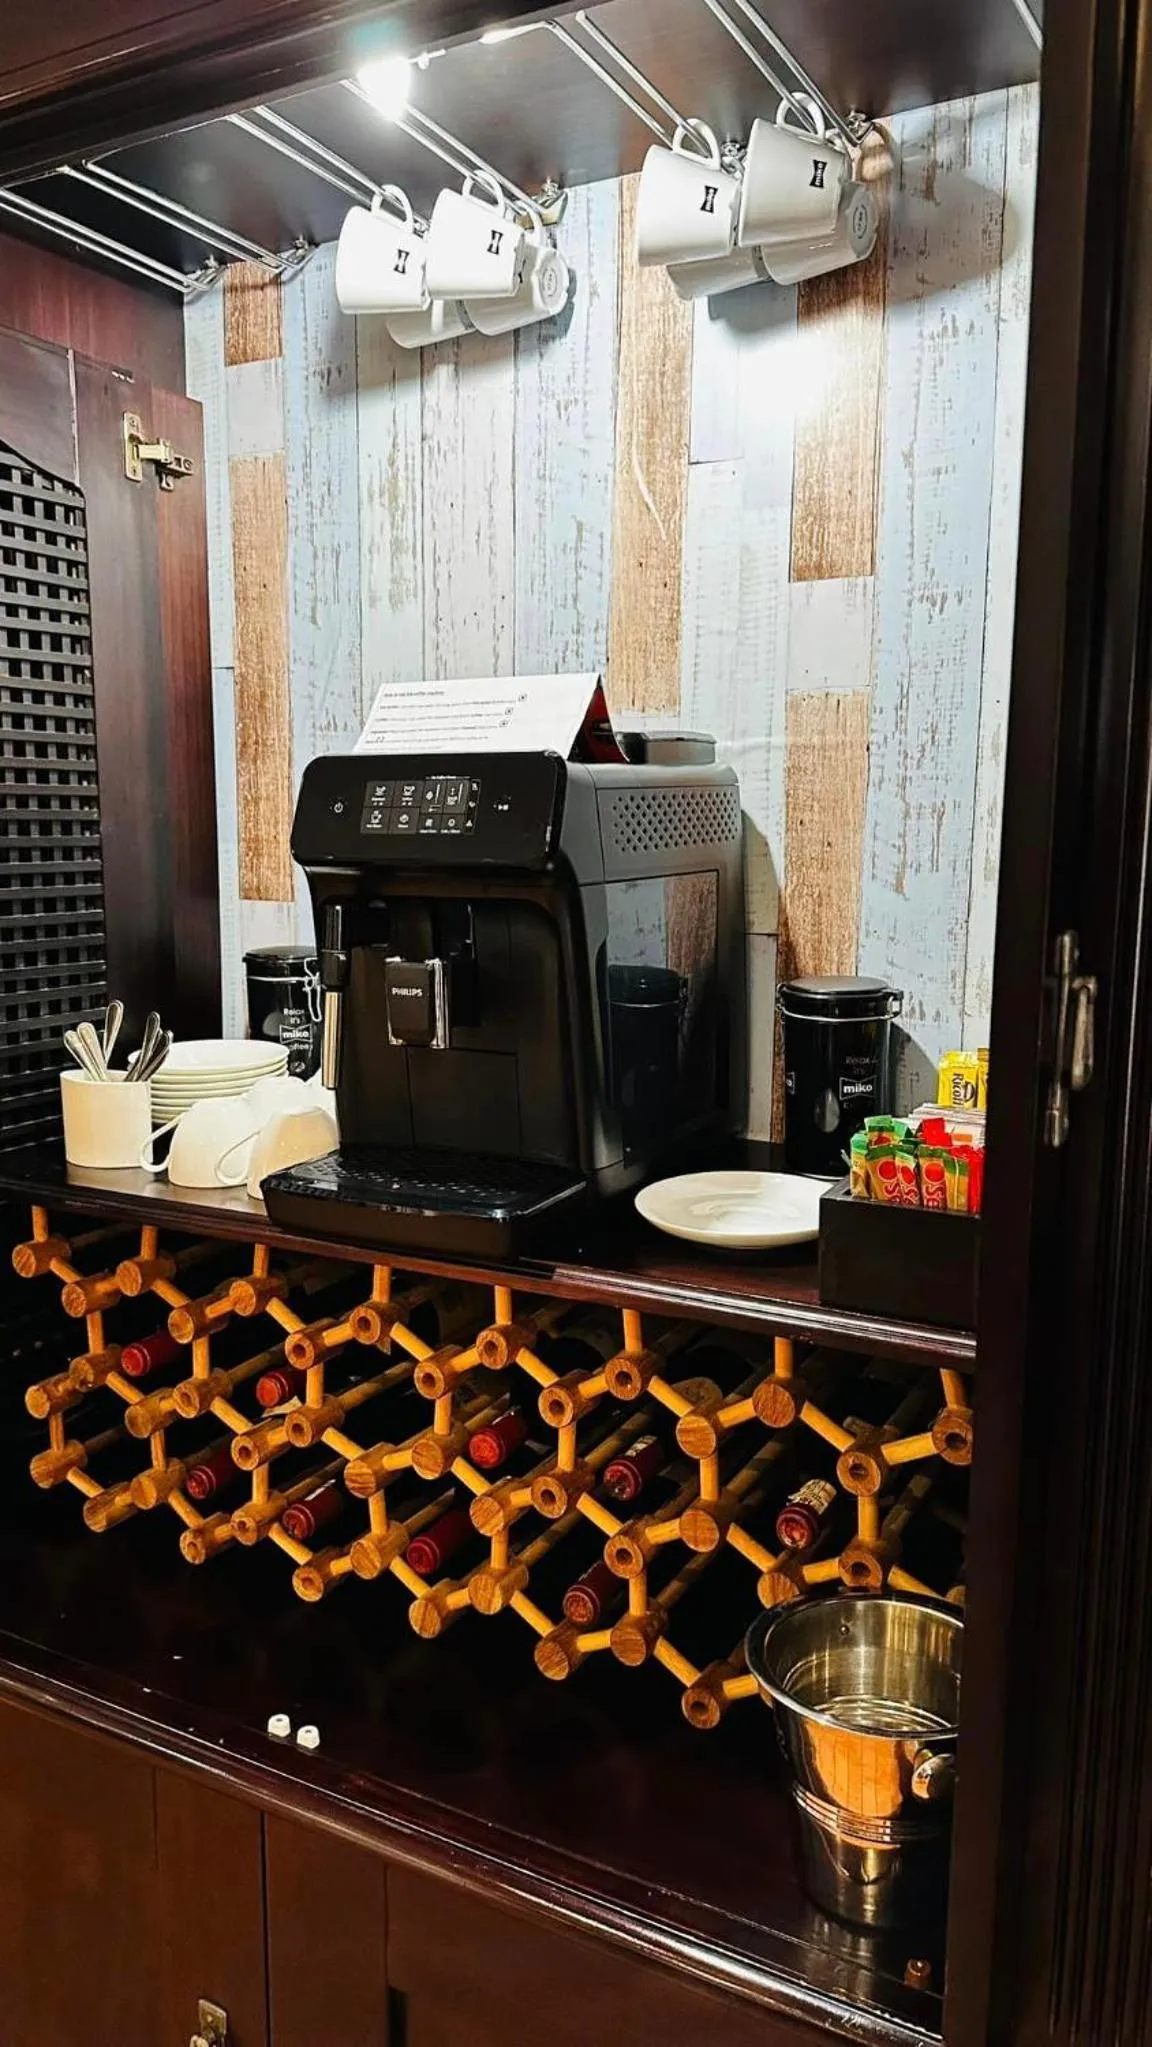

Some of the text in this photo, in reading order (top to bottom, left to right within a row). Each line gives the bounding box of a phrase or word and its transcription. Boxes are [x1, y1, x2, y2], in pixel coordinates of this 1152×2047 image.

[391, 987, 423, 997] PHILIPS
[282, 1029, 309, 1039] miko
[842, 1082, 873, 1094] miko
